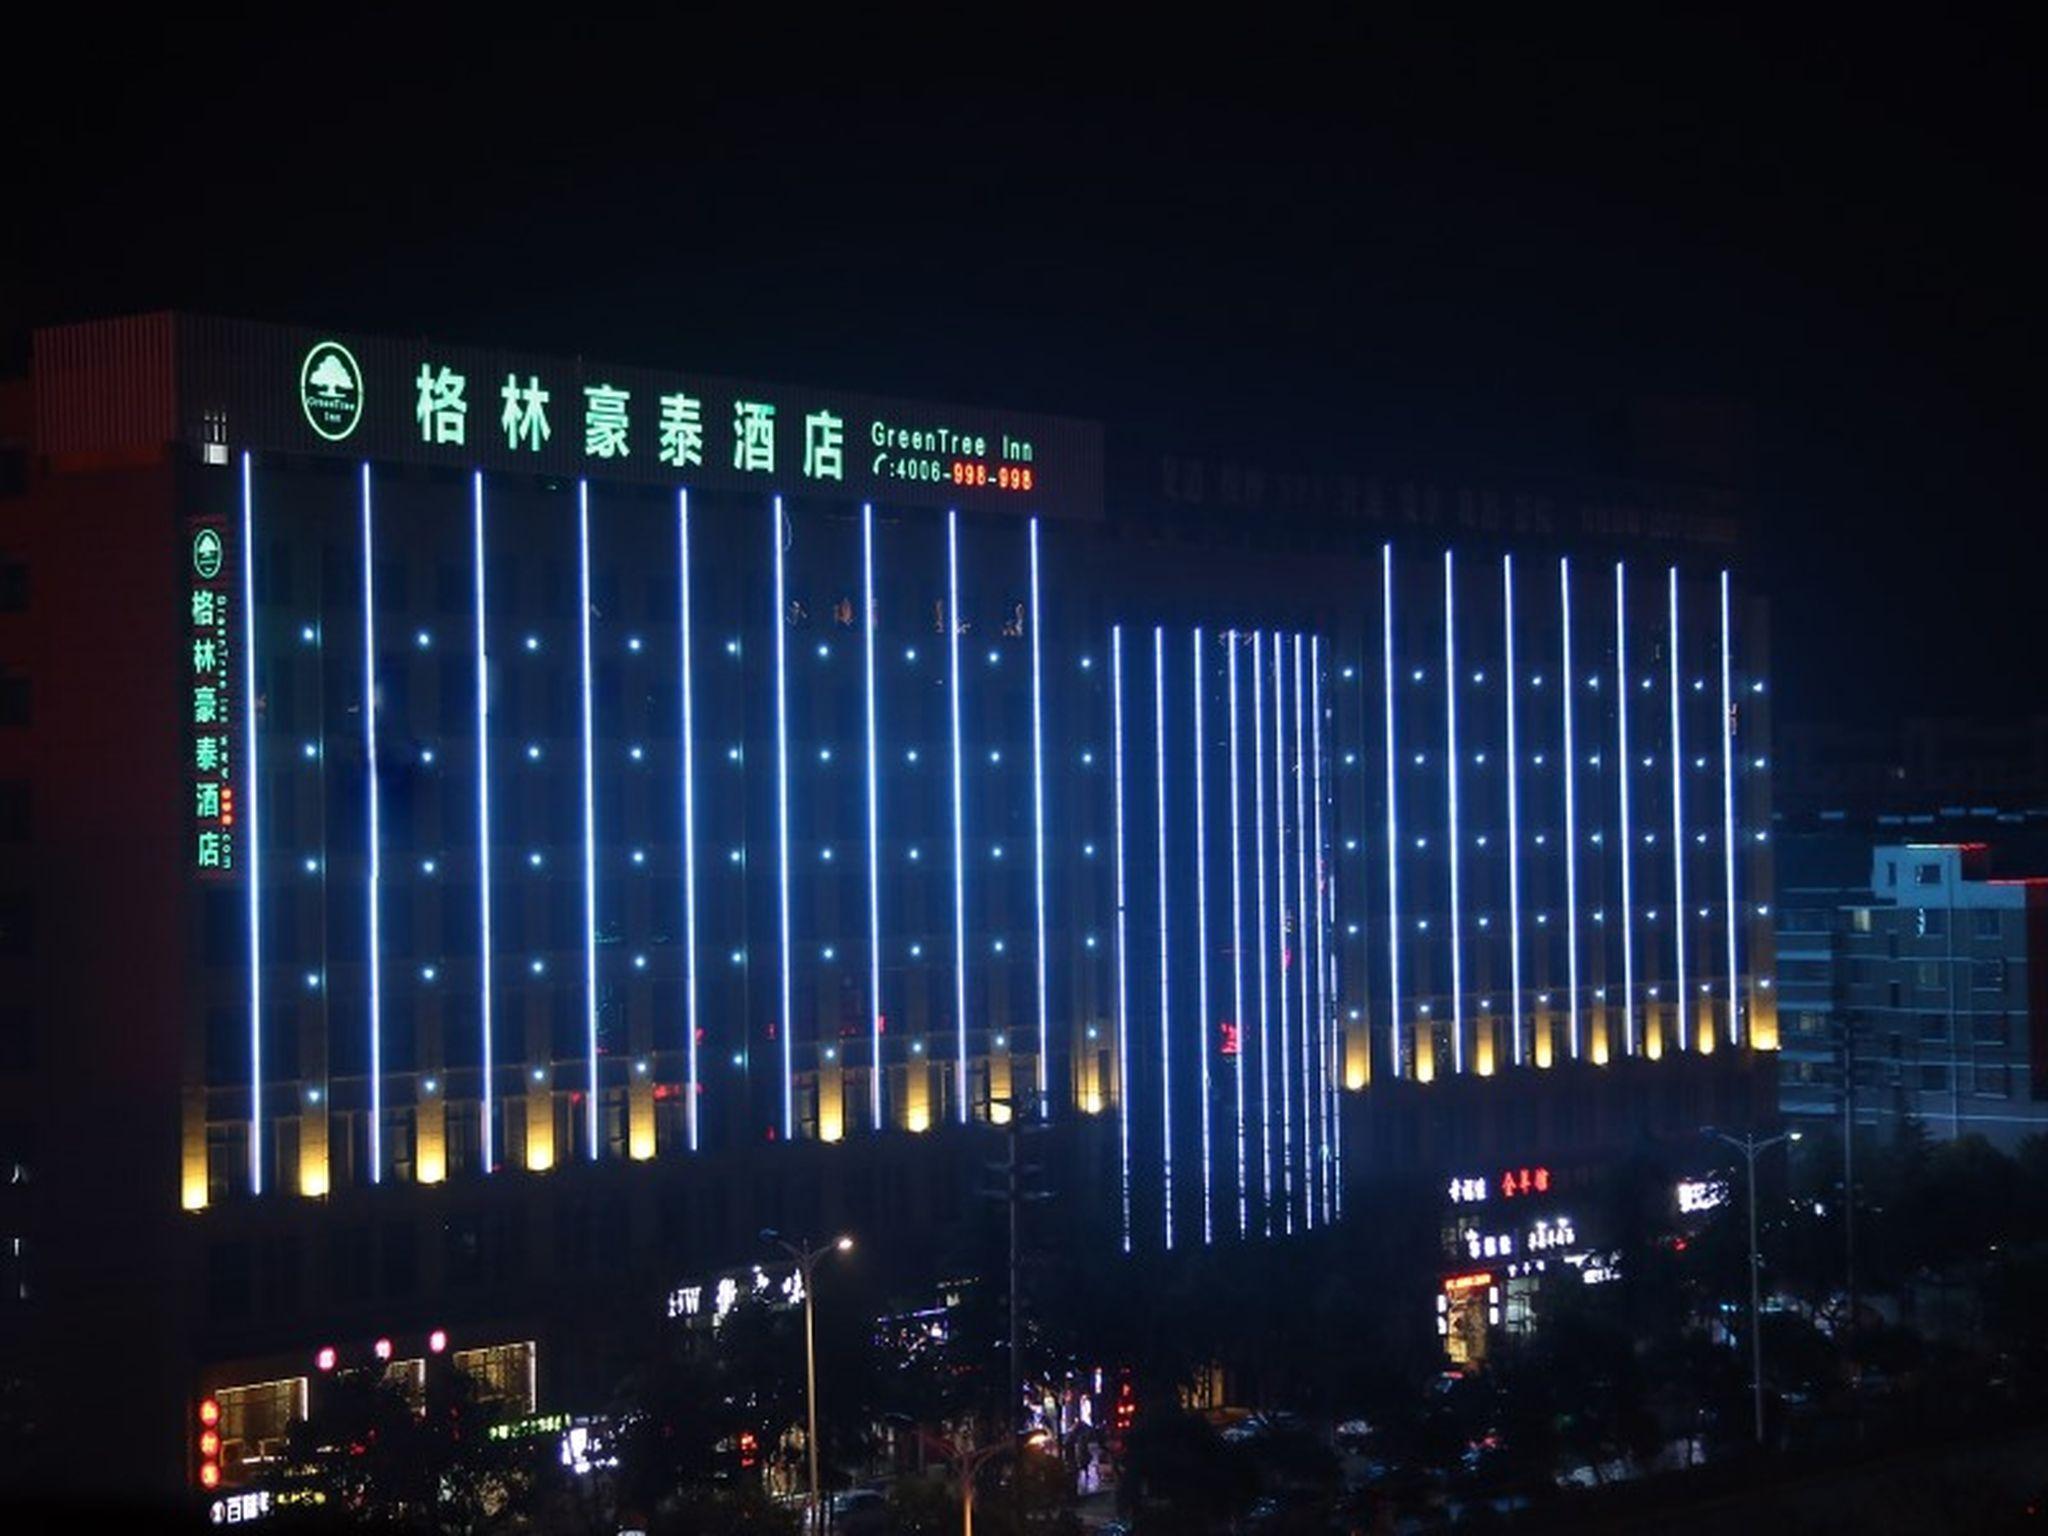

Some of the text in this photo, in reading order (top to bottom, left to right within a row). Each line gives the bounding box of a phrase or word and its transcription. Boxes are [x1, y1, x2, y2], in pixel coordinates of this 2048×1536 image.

[416, 362, 844, 481] 格林豪泰酒店
[871, 421, 1033, 462] GreenTree Inn
[191, 590, 219, 867] 格林豪泰酒店
